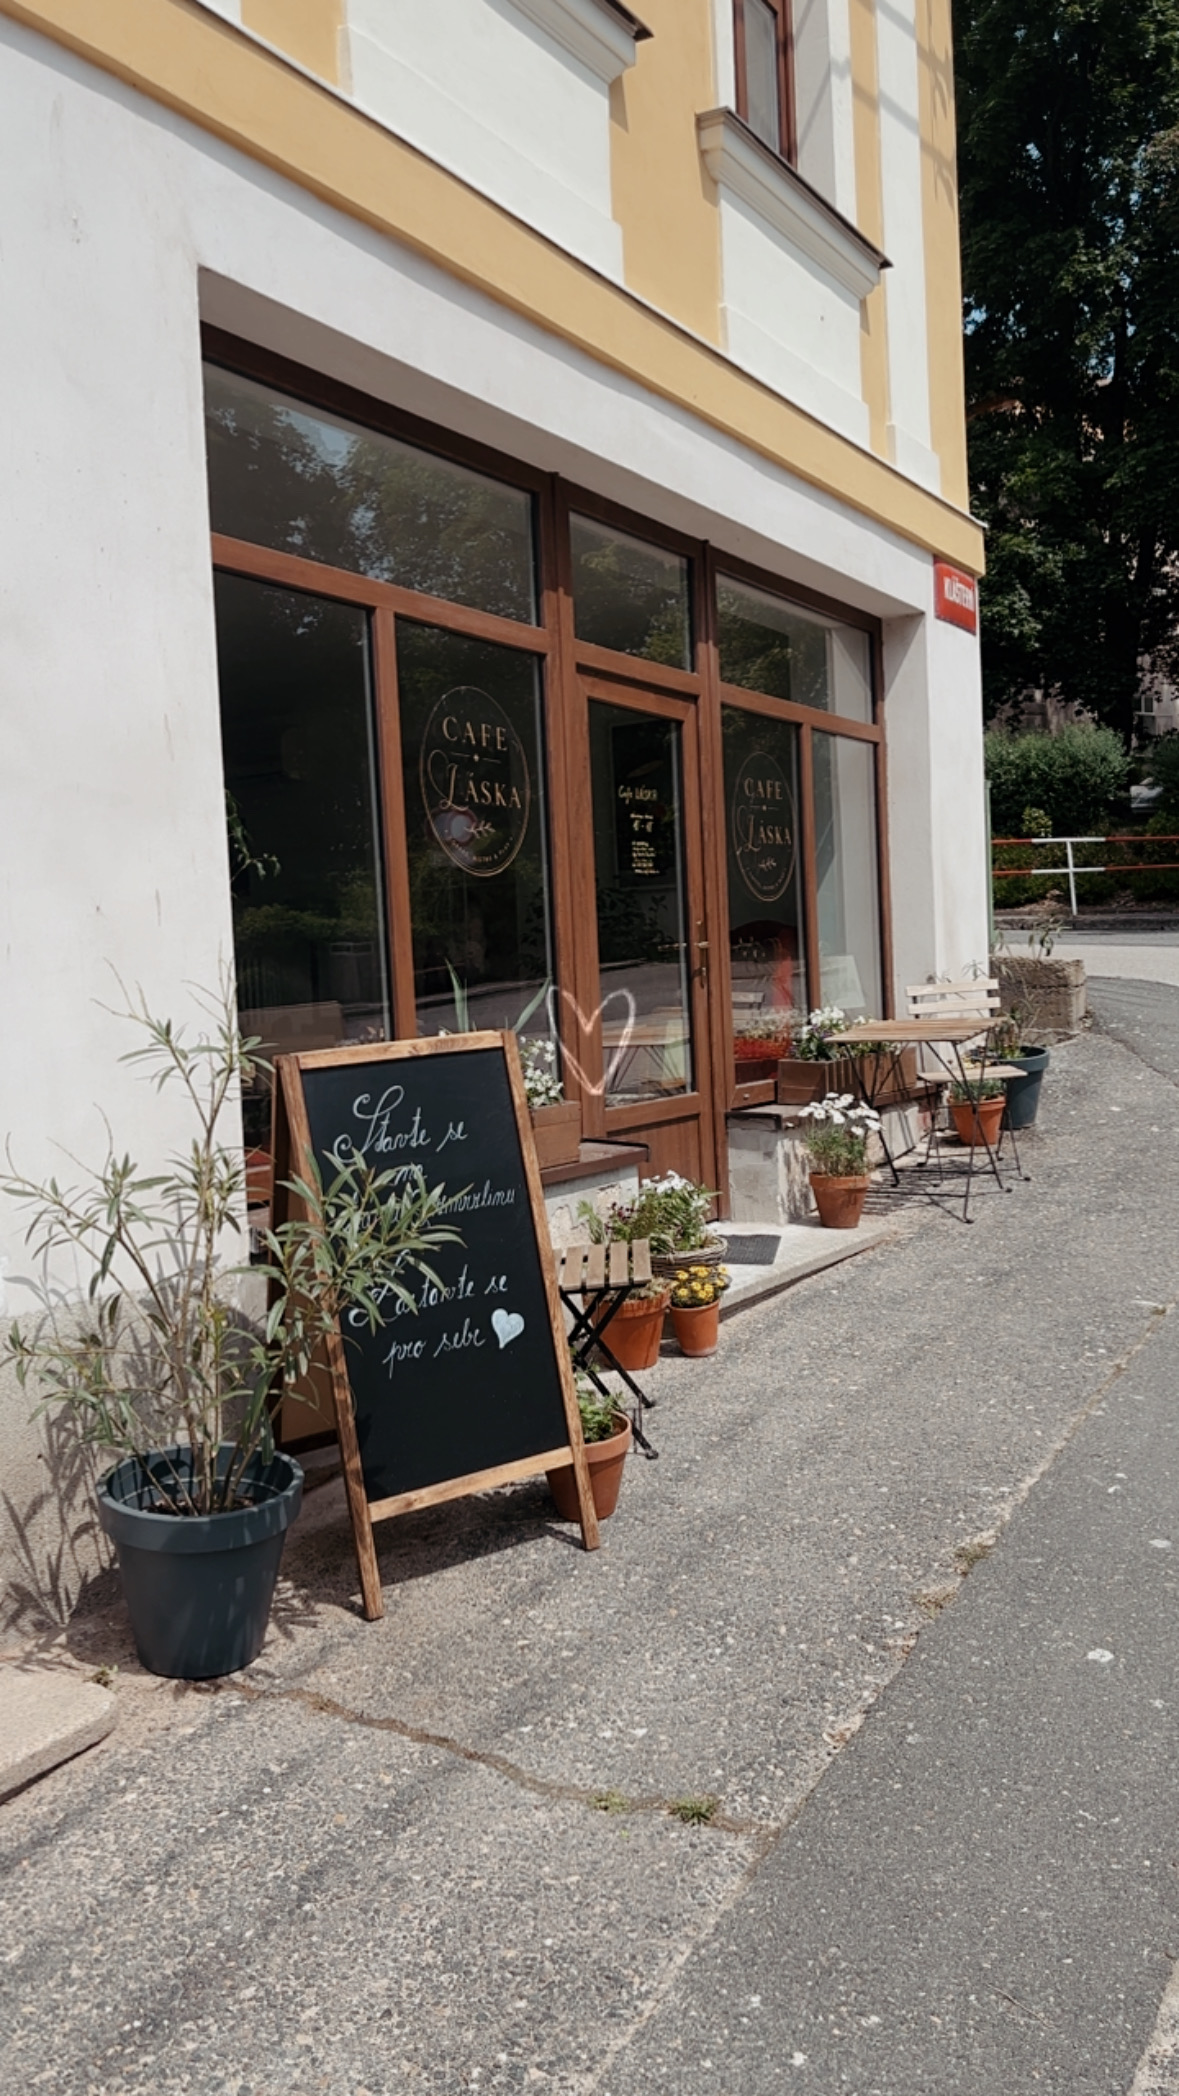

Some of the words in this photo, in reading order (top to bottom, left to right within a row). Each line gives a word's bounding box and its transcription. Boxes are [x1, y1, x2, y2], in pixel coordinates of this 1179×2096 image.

[442, 716, 508, 750] CAFE
[427, 750, 522, 812] LÁSKA
[744, 777, 783, 800] CAFE
[737, 805, 792, 851] LÁSKA
[436, 1121, 468, 1152] se
[484, 1275, 509, 1295] se
[382, 1339, 427, 1380] pro
[433, 1317, 487, 1358] sebe
